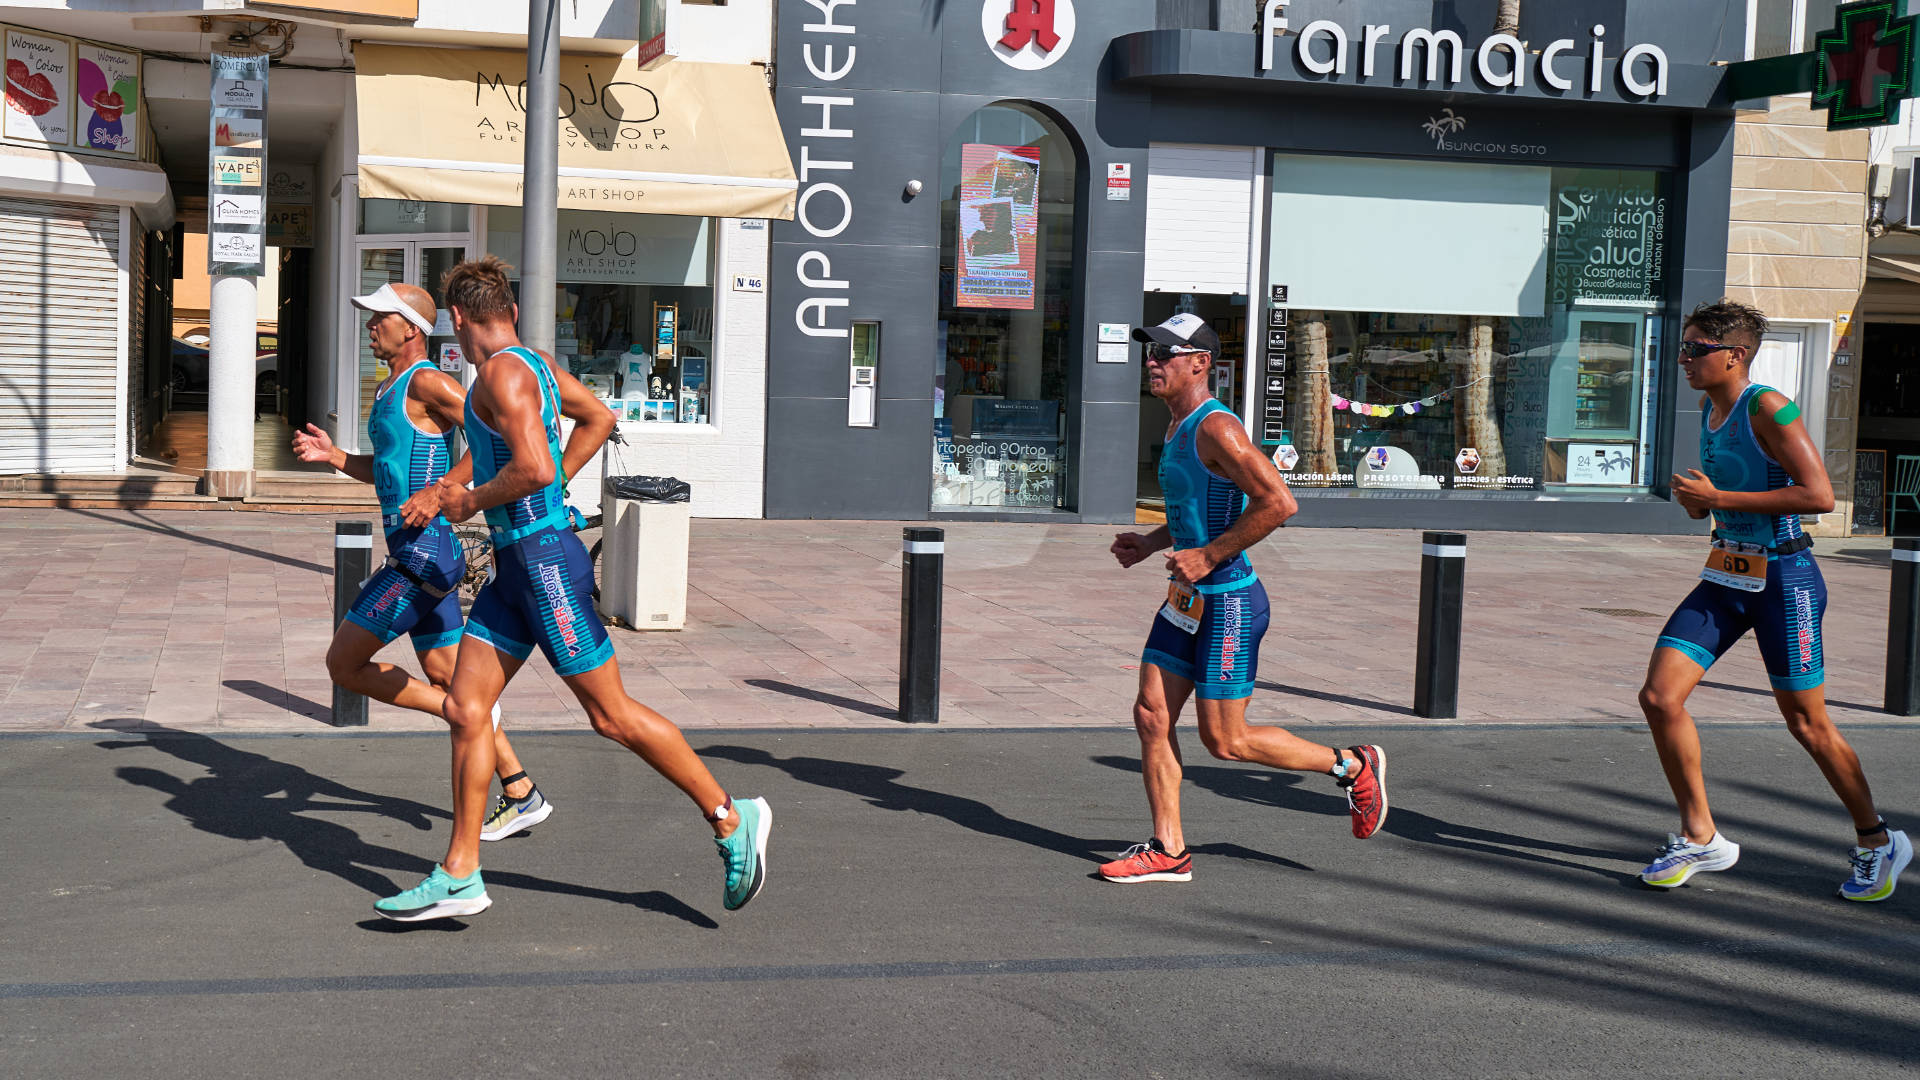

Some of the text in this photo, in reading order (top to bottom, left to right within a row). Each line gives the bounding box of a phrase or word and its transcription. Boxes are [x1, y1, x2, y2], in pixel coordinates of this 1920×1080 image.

[11, 35, 54, 53] Woman
[1261, 0, 1668, 97] farmacia
[97, 50, 129, 65] Woman
[35, 58, 64, 74] Colors
[214, 61, 268, 72] COMERCIAL
[477, 117, 666, 140] AR SHOP
[94, 127, 132, 149] Shop
[479, 133, 671, 150] FUEVENTURA
[1510, 144, 1547, 155] SOTO
[218, 163, 253, 173] VAPE
[568, 188, 597, 200] ART
[602, 189, 646, 201] SHOP
[270, 213, 299, 225] APE
[1574, 238, 1645, 266] Salud
[567, 257, 637, 268] ART SHOP
[1584, 264, 1641, 279] Cosmetic
[748, 279, 762, 288] 46
[938, 442, 997, 457] rtopedia
[1577, 455, 1591, 467] 24
[1723, 555, 1750, 573] 6D
[375, 549, 425, 611] INTERSORT
[541, 565, 578, 646] INTERSPORT
[1221, 596, 1236, 671] INTERSPORT
[1796, 589, 1811, 662] INTERSPORT
